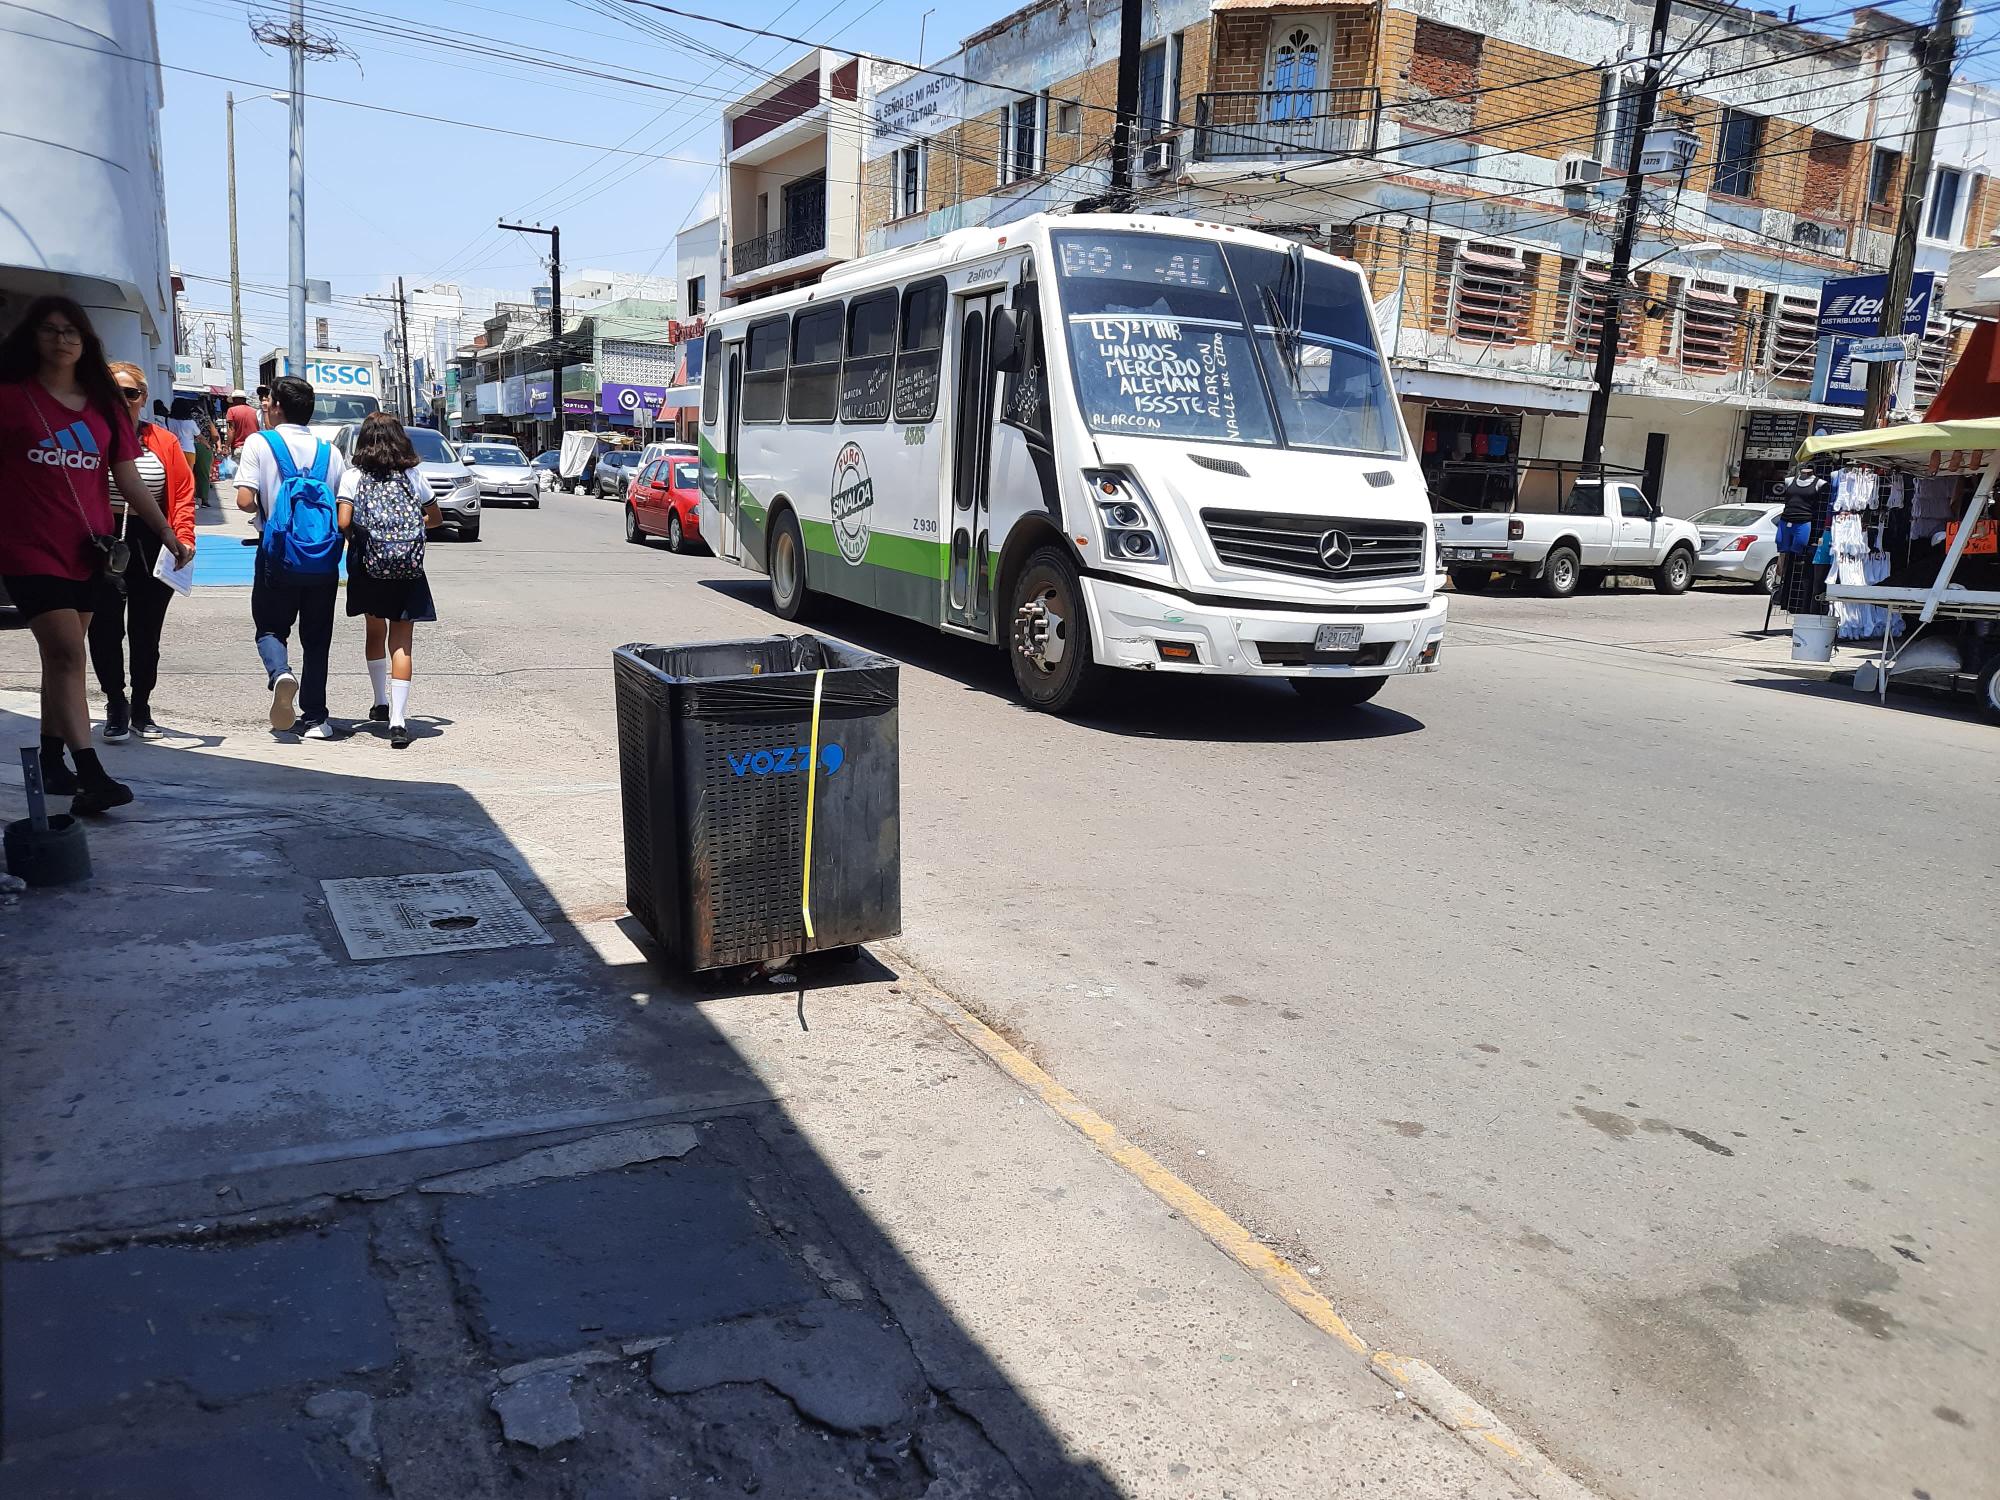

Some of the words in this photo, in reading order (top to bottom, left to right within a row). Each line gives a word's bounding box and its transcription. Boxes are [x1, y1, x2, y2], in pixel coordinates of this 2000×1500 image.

[875, 109, 882, 121] EL
[884, 96, 904, 118] SEÑOR
[906, 92, 914, 108] ES
[915, 87, 925, 104] MI
[893, 116, 905, 130] ME
[906, 101, 938, 126] FALTARA
[967, 268, 992, 284] Zafiro
[1849, 292, 1926, 316] telel
[1821, 317, 1871, 325] DISTRIBUIDOR
[1090, 320, 1130, 345] LEY
[1143, 320, 1182, 341] MAR
[1100, 343, 1178, 361] UNIDOS
[1849, 343, 1880, 351] AQUILES
[284, 356, 371, 386] rissa
[1105, 358, 1200, 378] MERCADO
[1120, 377, 1200, 396] ALEMAN
[1197, 343, 1221, 418] ALARCON
[1221, 371, 1229, 388] DEL
[1829, 381, 1869, 391] DISTRI
[1134, 396, 1206, 415] ISSSTE
[1223, 392, 1240, 438] VALLE
[1092, 414, 1161, 428] ALARCON
[838, 448, 860, 473] PURO
[832, 482, 872, 519] SINALOA
[913, 518, 920, 531] Z
[920, 519, 937, 533] 930
[839, 524, 868, 554] CALIDAD
